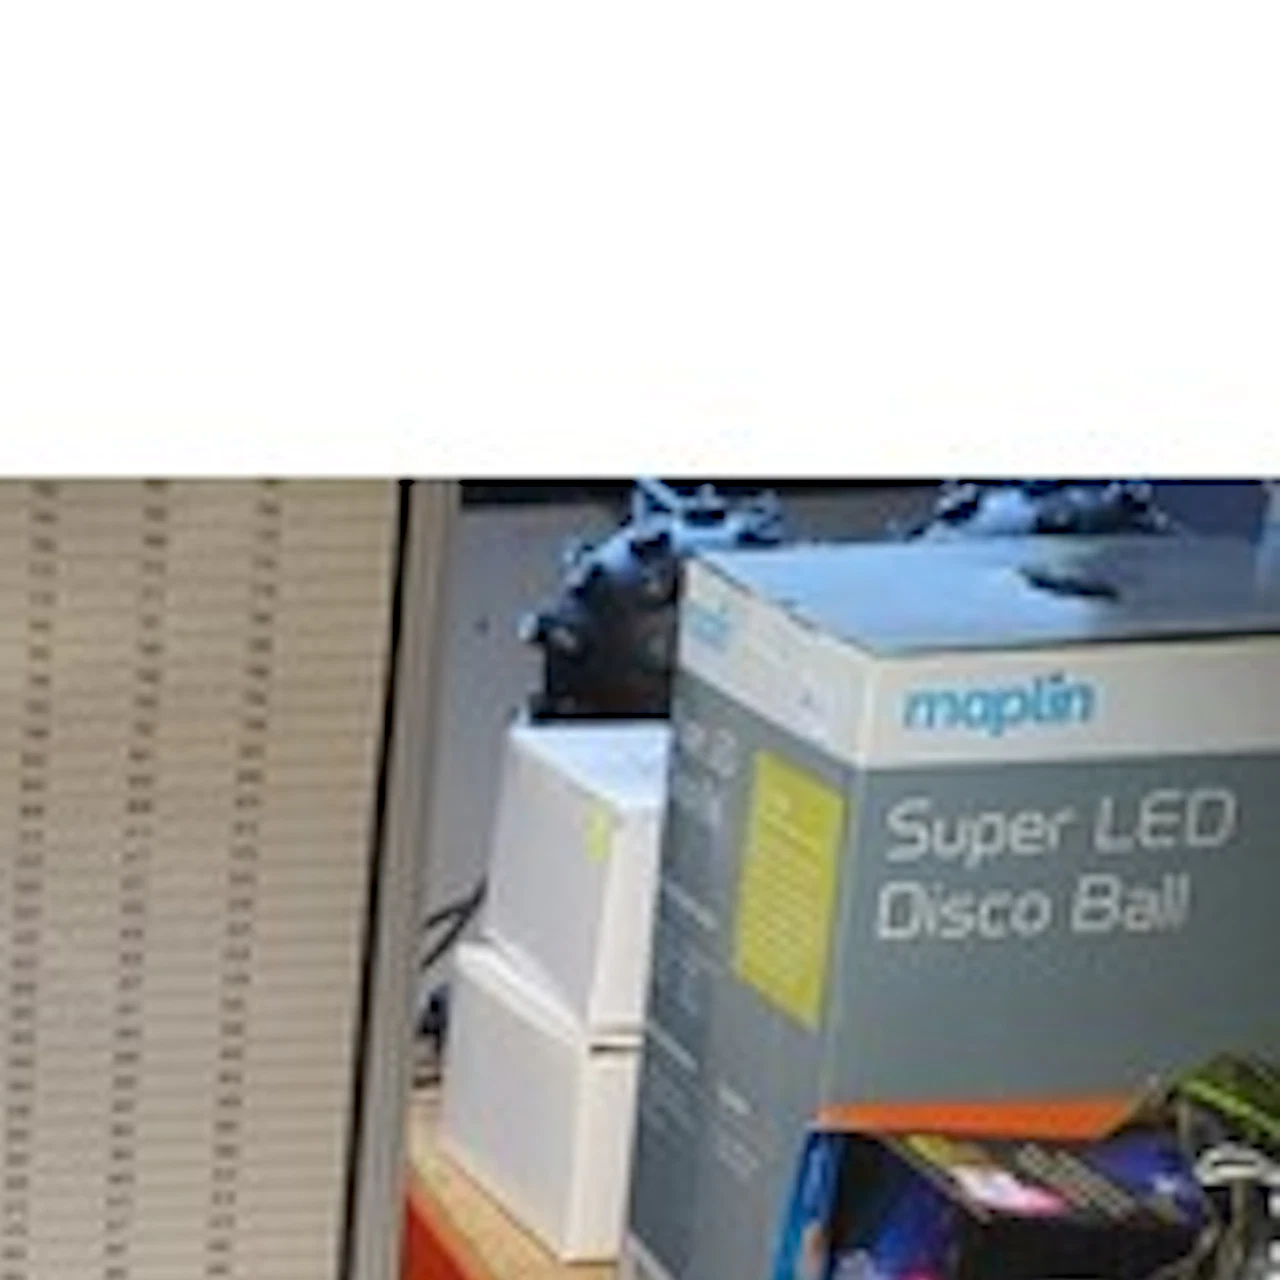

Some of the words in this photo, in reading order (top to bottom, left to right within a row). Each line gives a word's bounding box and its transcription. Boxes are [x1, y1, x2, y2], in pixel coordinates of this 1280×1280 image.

[902, 672, 1096, 738] maplin
[884, 797, 1076, 868] Super
[1093, 789, 1236, 853] LED
[877, 880, 1052, 940] Disco
[1070, 873, 1190, 934] Ball
